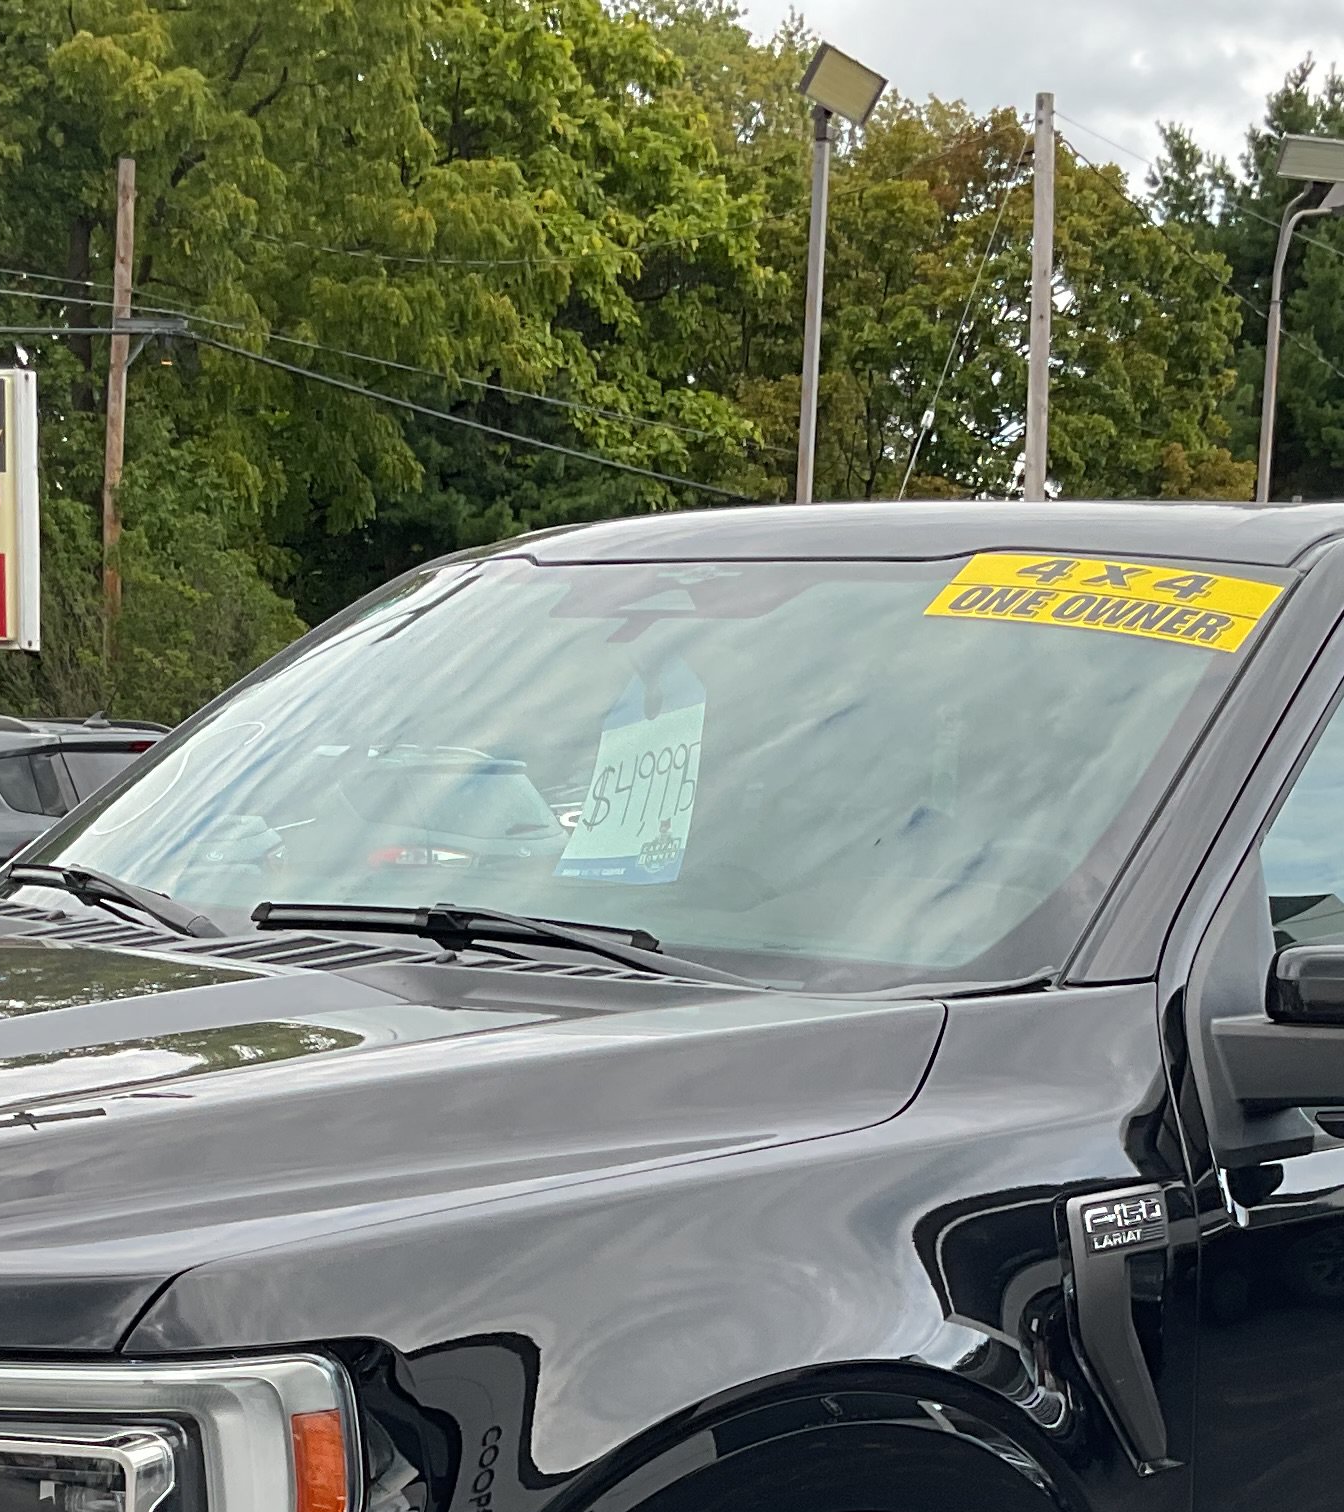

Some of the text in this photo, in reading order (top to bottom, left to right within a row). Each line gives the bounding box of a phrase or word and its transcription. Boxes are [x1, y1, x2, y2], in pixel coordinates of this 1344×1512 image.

[948, 586, 1236, 645] ONE OWNER
[1093, 1228, 1143, 1250] LARIAT
